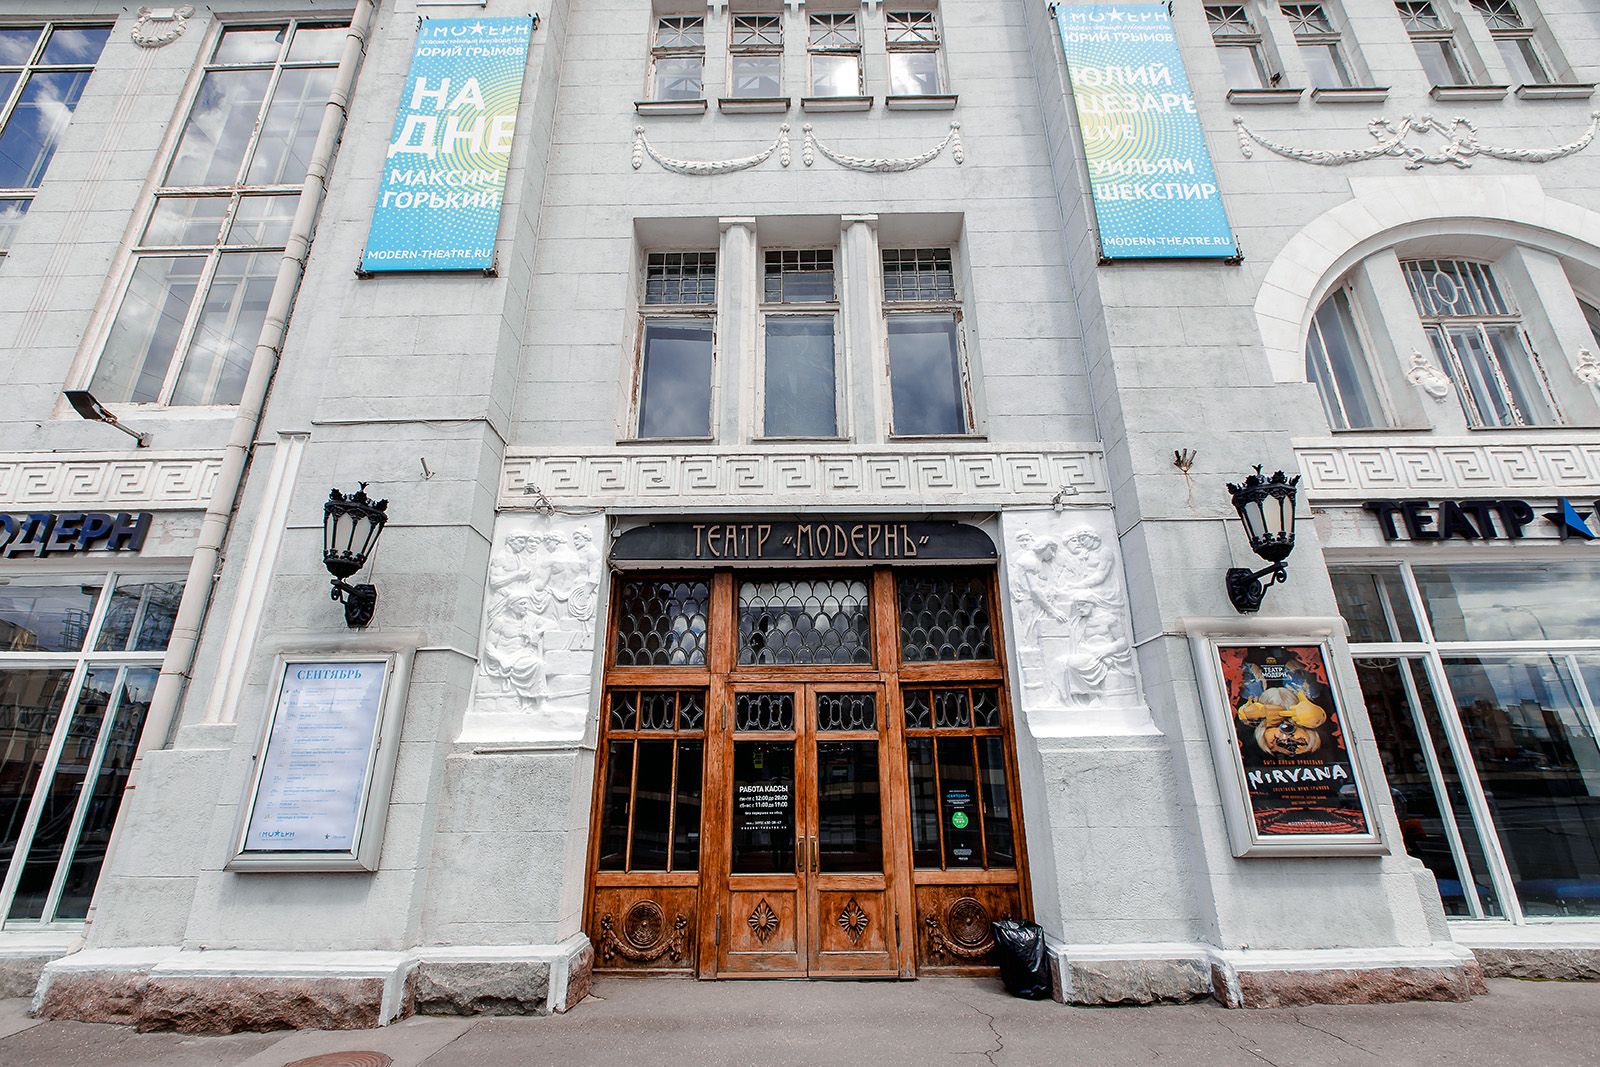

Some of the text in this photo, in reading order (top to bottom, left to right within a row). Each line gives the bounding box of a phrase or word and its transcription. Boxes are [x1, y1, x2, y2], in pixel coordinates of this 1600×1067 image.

[1064, 31, 1174, 42] ЮРИЙ ГРЫМОВ
[416, 45, 525, 57] ЮРИЙ ГРЫМОВ
[1073, 63, 1172, 86] ЮЛИЙ
[410, 76, 486, 111] НА
[1080, 94, 1197, 116] ЦЕЗАРЬ
[387, 115, 517, 160] ДНЕ
[1084, 124, 1136, 140] LIVE
[1090, 158, 1196, 176] УИЛЬЯМ
[389, 168, 500, 187] МАКСИМ
[382, 189, 499, 209] ГОРЬКИЙ
[1095, 183, 1217, 201] ШЕКСПИР
[1105, 236, 1231, 247] MODERN-THEATRE.RU
[368, 249, 492, 260] MODERN-THEATRE.RU
[1362, 499, 1535, 541] ТЕАТР
[693, 524, 772, 558] ТЕАТР
[297, 669, 362, 680] СЕНТЯБРЬ
